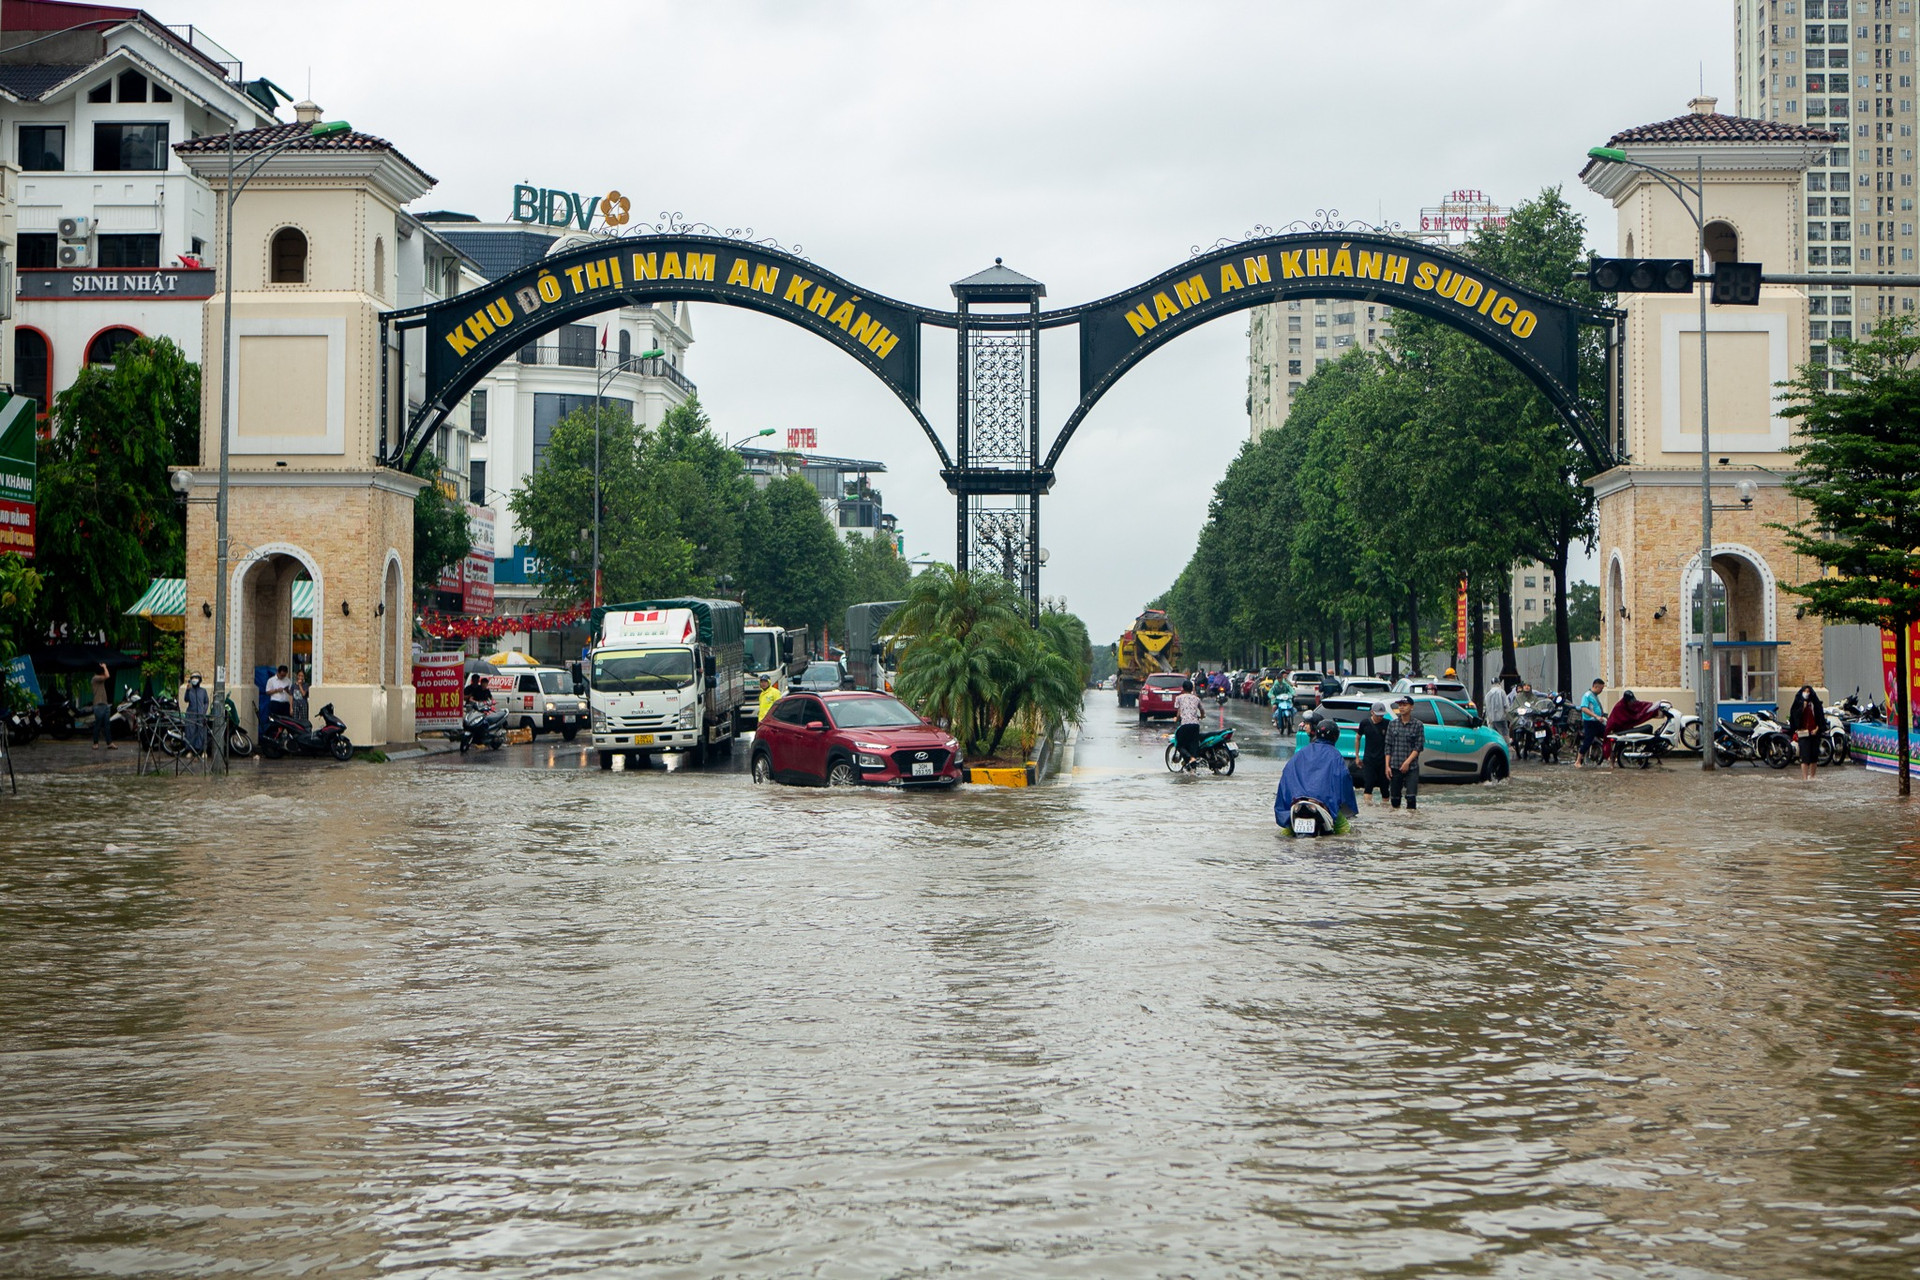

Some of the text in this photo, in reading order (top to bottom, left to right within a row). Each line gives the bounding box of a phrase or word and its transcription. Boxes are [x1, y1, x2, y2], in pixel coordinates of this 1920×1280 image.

[1452, 189, 1482, 201] 18T1
[513, 184, 602, 231] BIDV
[72, 271, 178, 294] SINH NHẬT
[1124, 242, 1538, 339] NAM AN KHÁNH SUDICO
[445, 252, 900, 360] KHU ĐÔ THỊ NAM AN KHÁNH
[787, 428, 817, 448] HOTEL
[5, 473, 32, 491] KHÁNH
[425, 693, 434, 708] GA
[440, 692, 449, 708] XE
